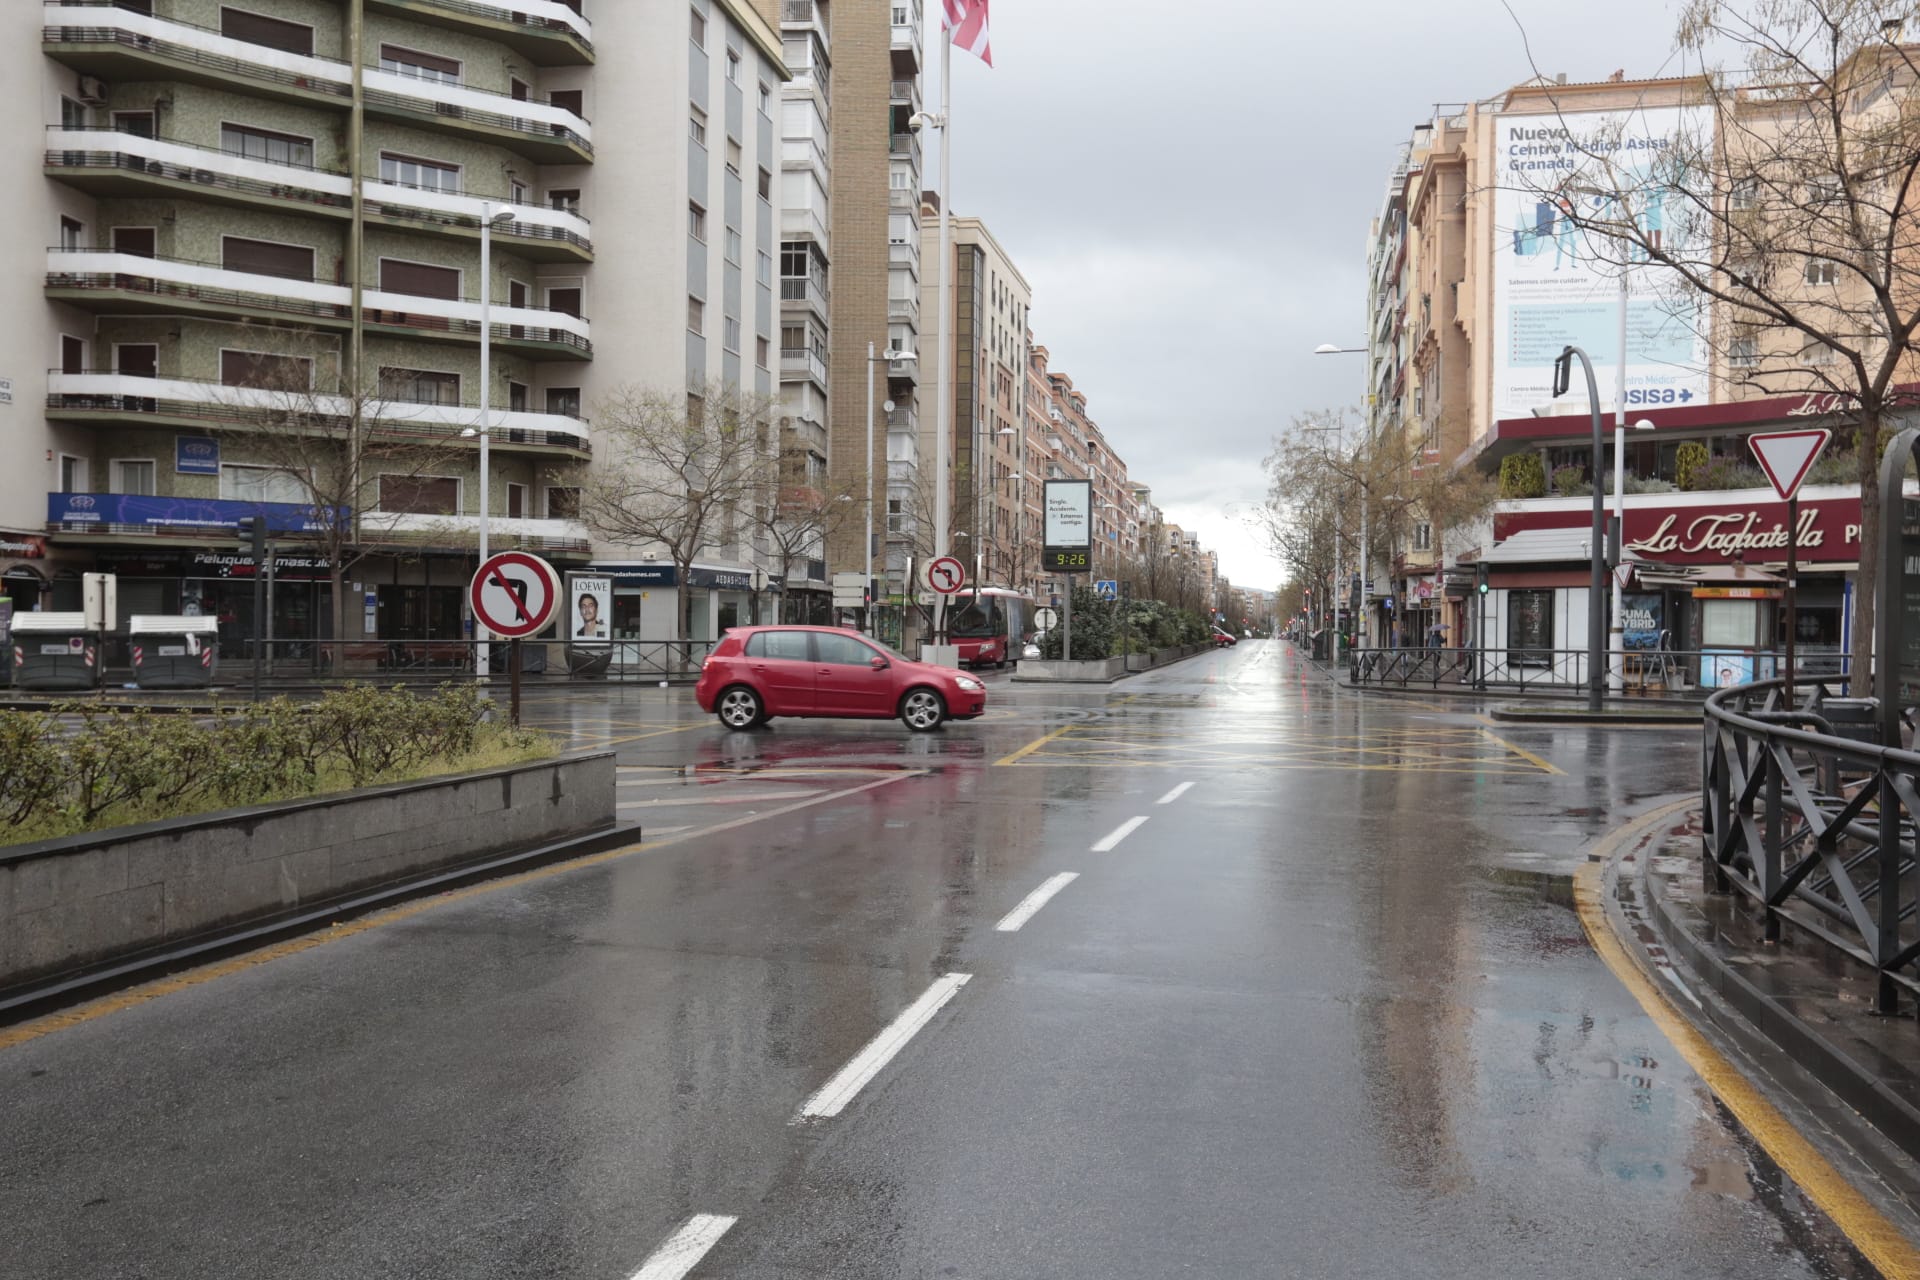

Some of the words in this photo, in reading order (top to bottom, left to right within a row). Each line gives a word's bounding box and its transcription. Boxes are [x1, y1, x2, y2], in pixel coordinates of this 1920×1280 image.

[1509, 127, 1569, 141] Nuevo
[1509, 143, 1561, 156] Centro
[1565, 138, 1622, 153] Médico
[1626, 137, 1669, 150] Asisa
[1509, 157, 1575, 171] Granada
[1624, 513, 1679, 553] La
[1679, 508, 1825, 557] Tagliatella
[1057, 554, 1086, 565] 9:26
[574, 581, 609, 592] LOEWE
[1620, 609, 1652, 620] PUMA
